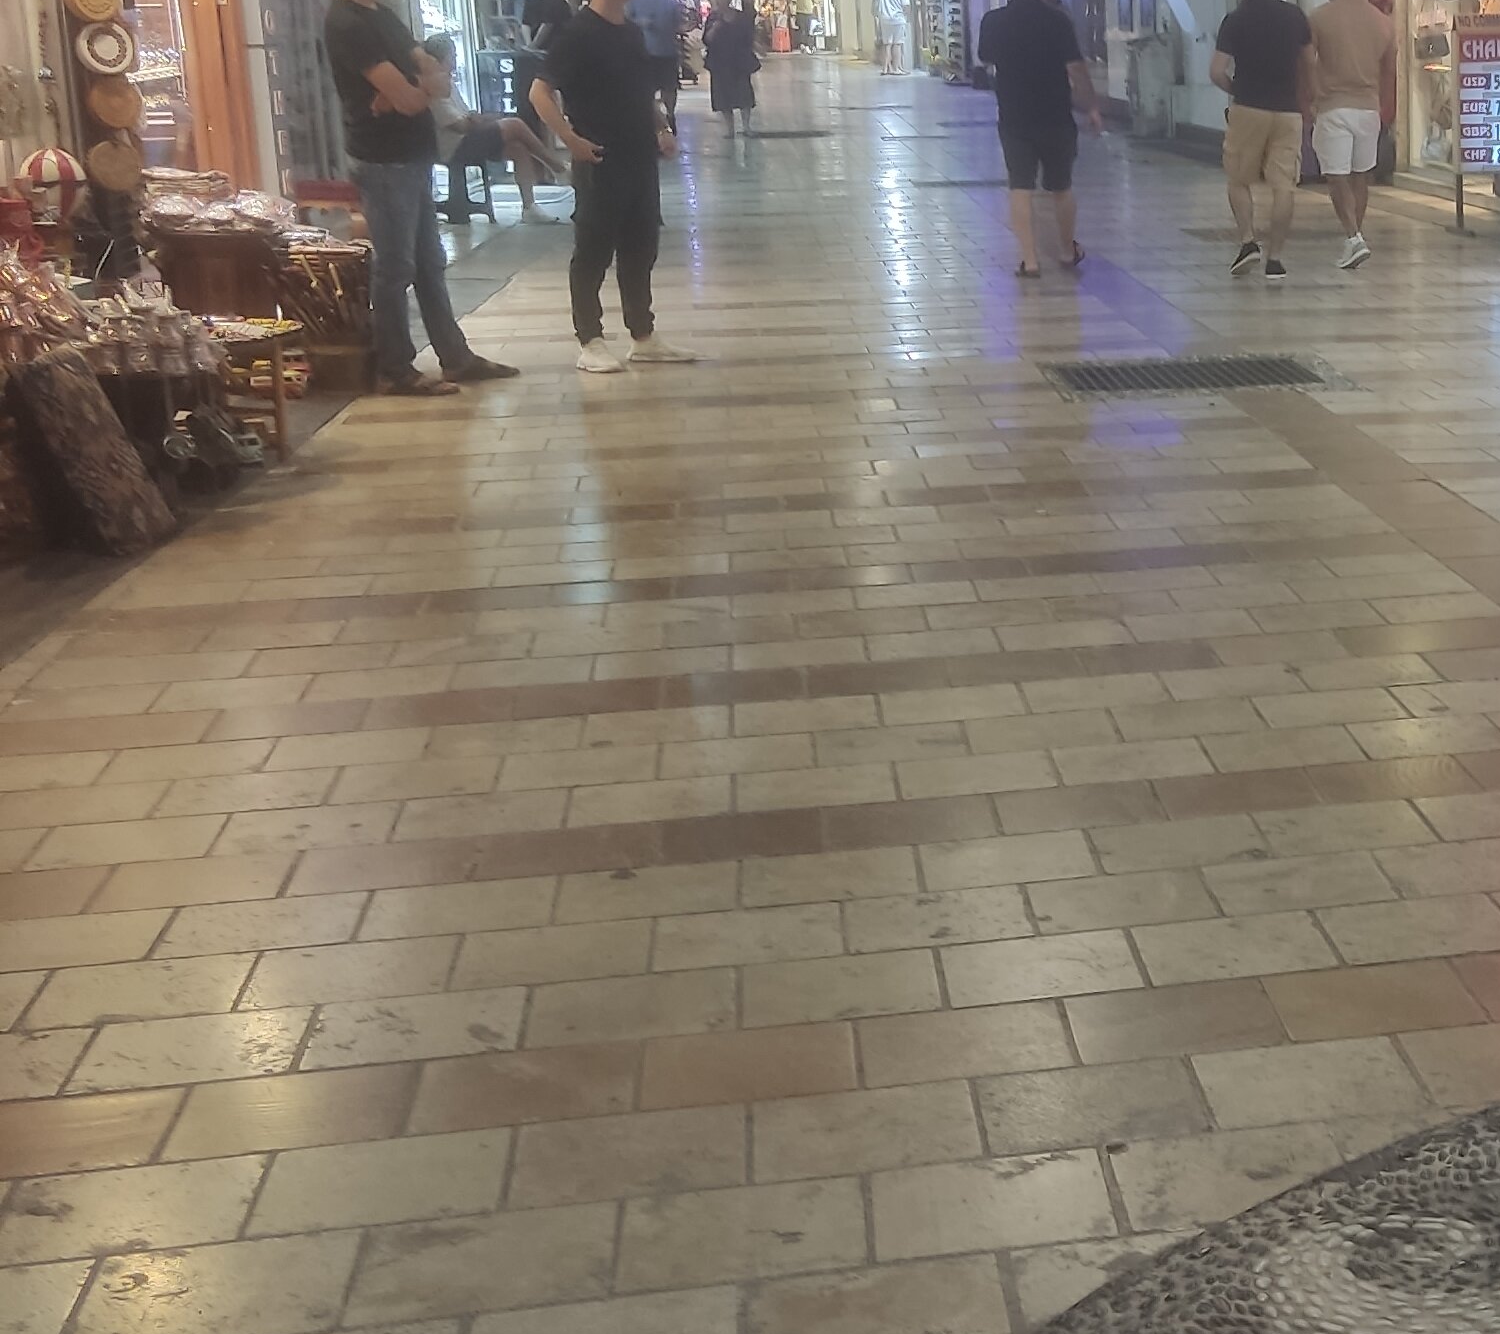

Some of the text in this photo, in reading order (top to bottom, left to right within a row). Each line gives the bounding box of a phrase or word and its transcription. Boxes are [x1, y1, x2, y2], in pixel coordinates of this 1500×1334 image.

[1462, 76, 1487, 88] USD
[1462, 102, 1487, 114] EUR
[1463, 148, 1487, 161] CHF
